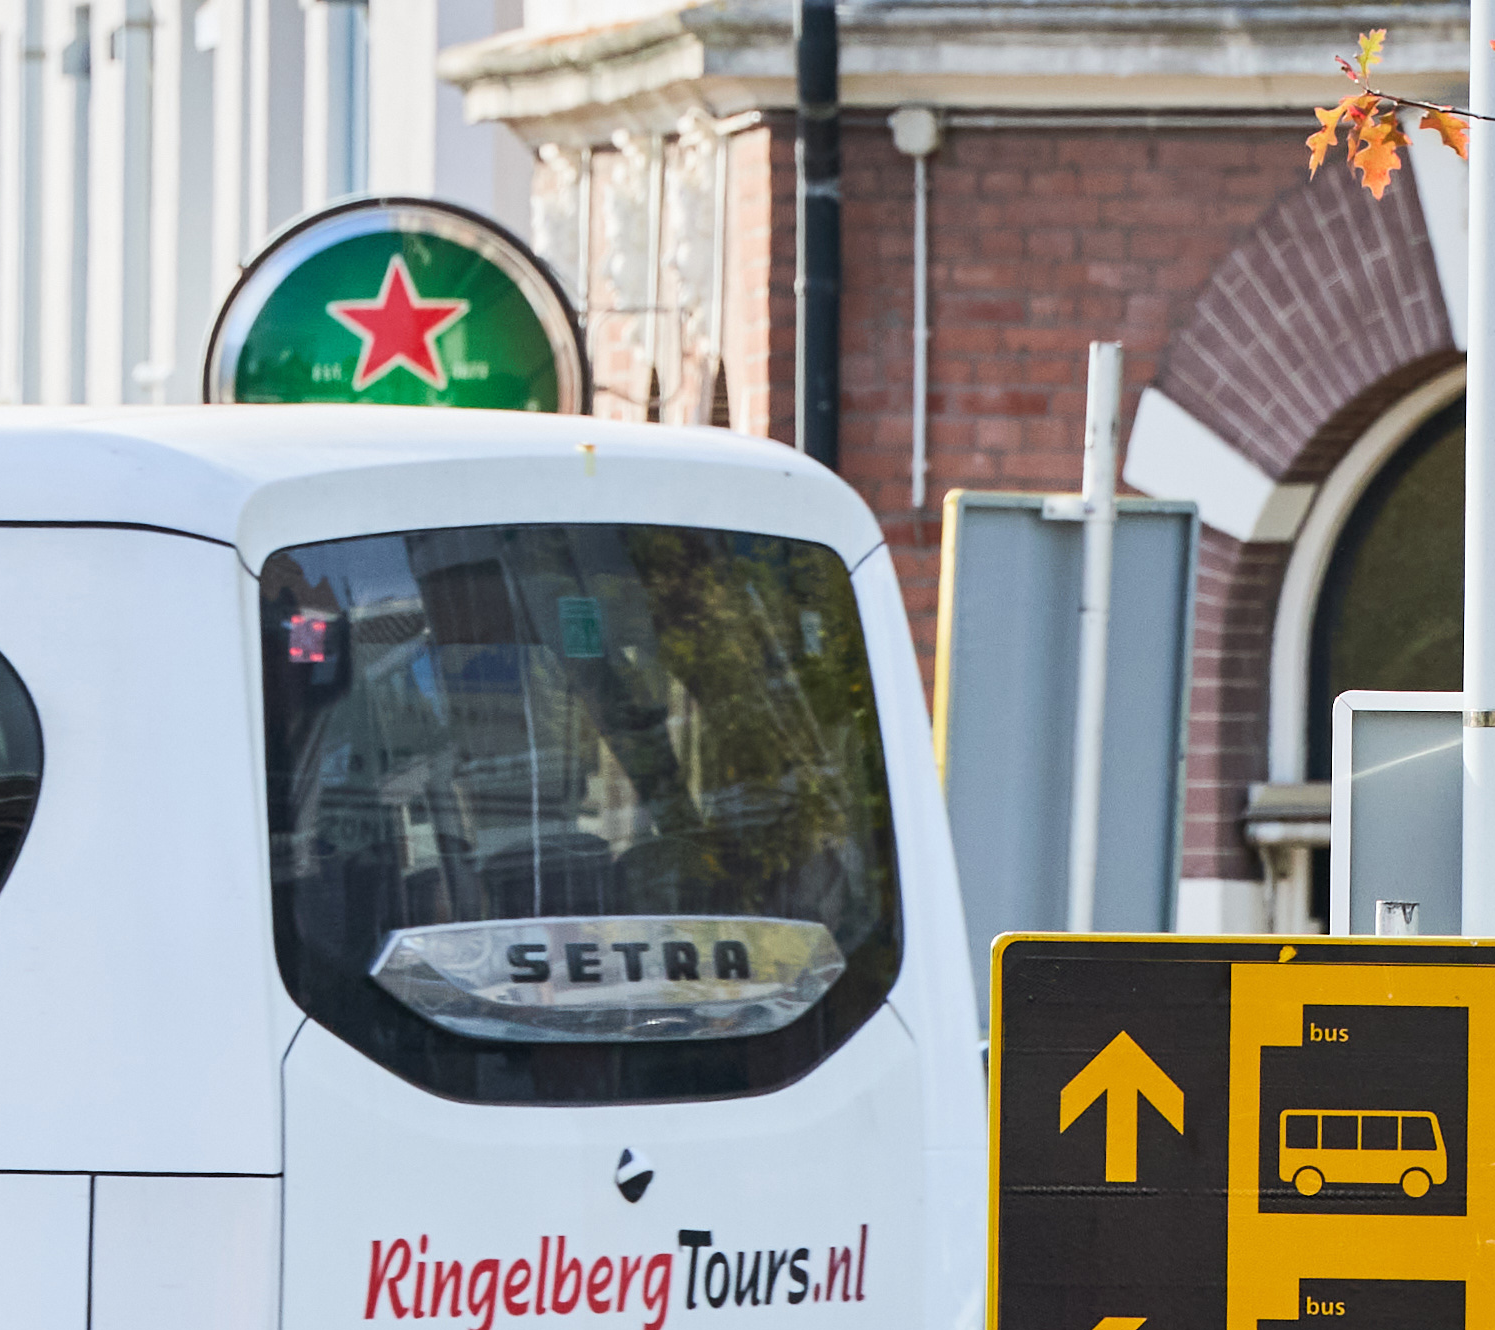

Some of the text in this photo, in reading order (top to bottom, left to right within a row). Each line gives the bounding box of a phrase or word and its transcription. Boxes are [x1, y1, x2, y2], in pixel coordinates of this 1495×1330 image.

[507, 940, 753, 984] SETRA
[1310, 1022, 1349, 1043] bus
[1306, 1295, 1346, 1316] bus
